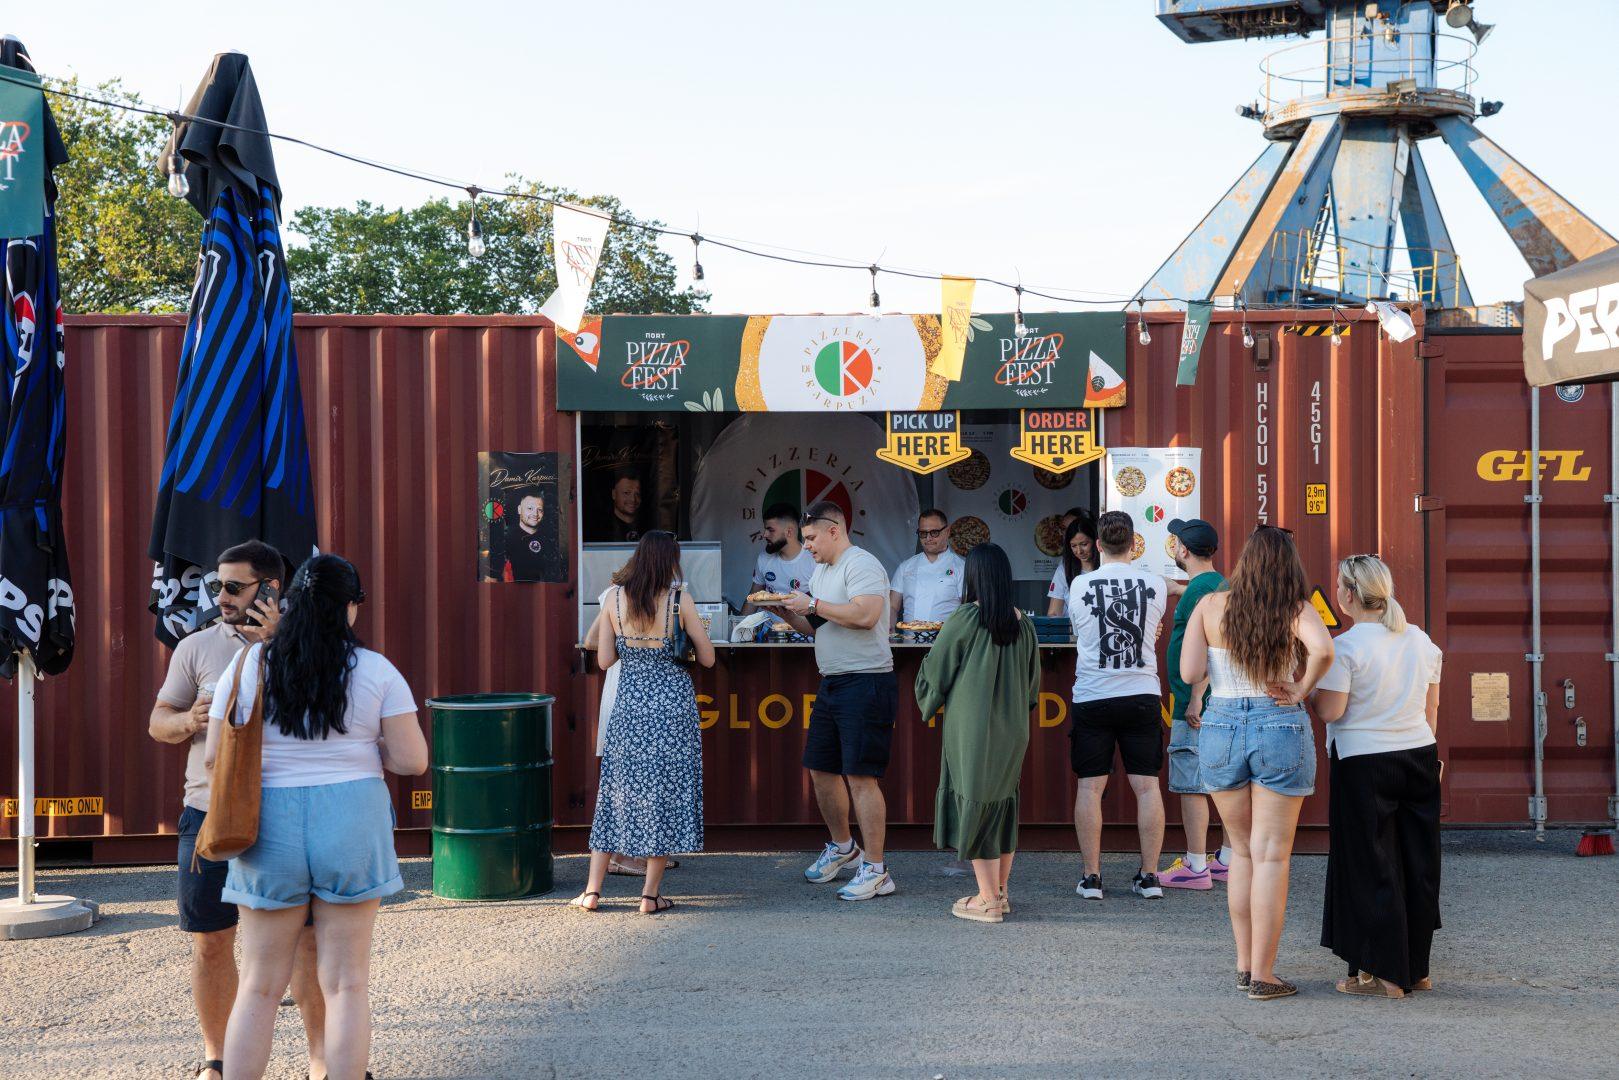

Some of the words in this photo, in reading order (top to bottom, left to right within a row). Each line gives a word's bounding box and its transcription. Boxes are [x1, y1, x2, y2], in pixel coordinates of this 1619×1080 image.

[625, 341, 687, 366] PIZZA
[999, 336, 1061, 362] PIZZA
[630, 366, 682, 390] FEST
[1004, 361, 1056, 386] FEST
[893, 414, 928, 431] PICK
[933, 413, 954, 430] UP
[1028, 412, 1087, 430] ORDER
[1257, 382, 1268, 466] HCOU
[1310, 381, 1321, 465] 45G1
[896, 435, 951, 456] HERE
[1031, 434, 1085, 455] HERE
[746, 446, 865, 493] PIZZERIA
[1476, 449, 1592, 482] GFL
[77, 798, 101, 813] ONLY
[414, 792, 432, 807] EMP
